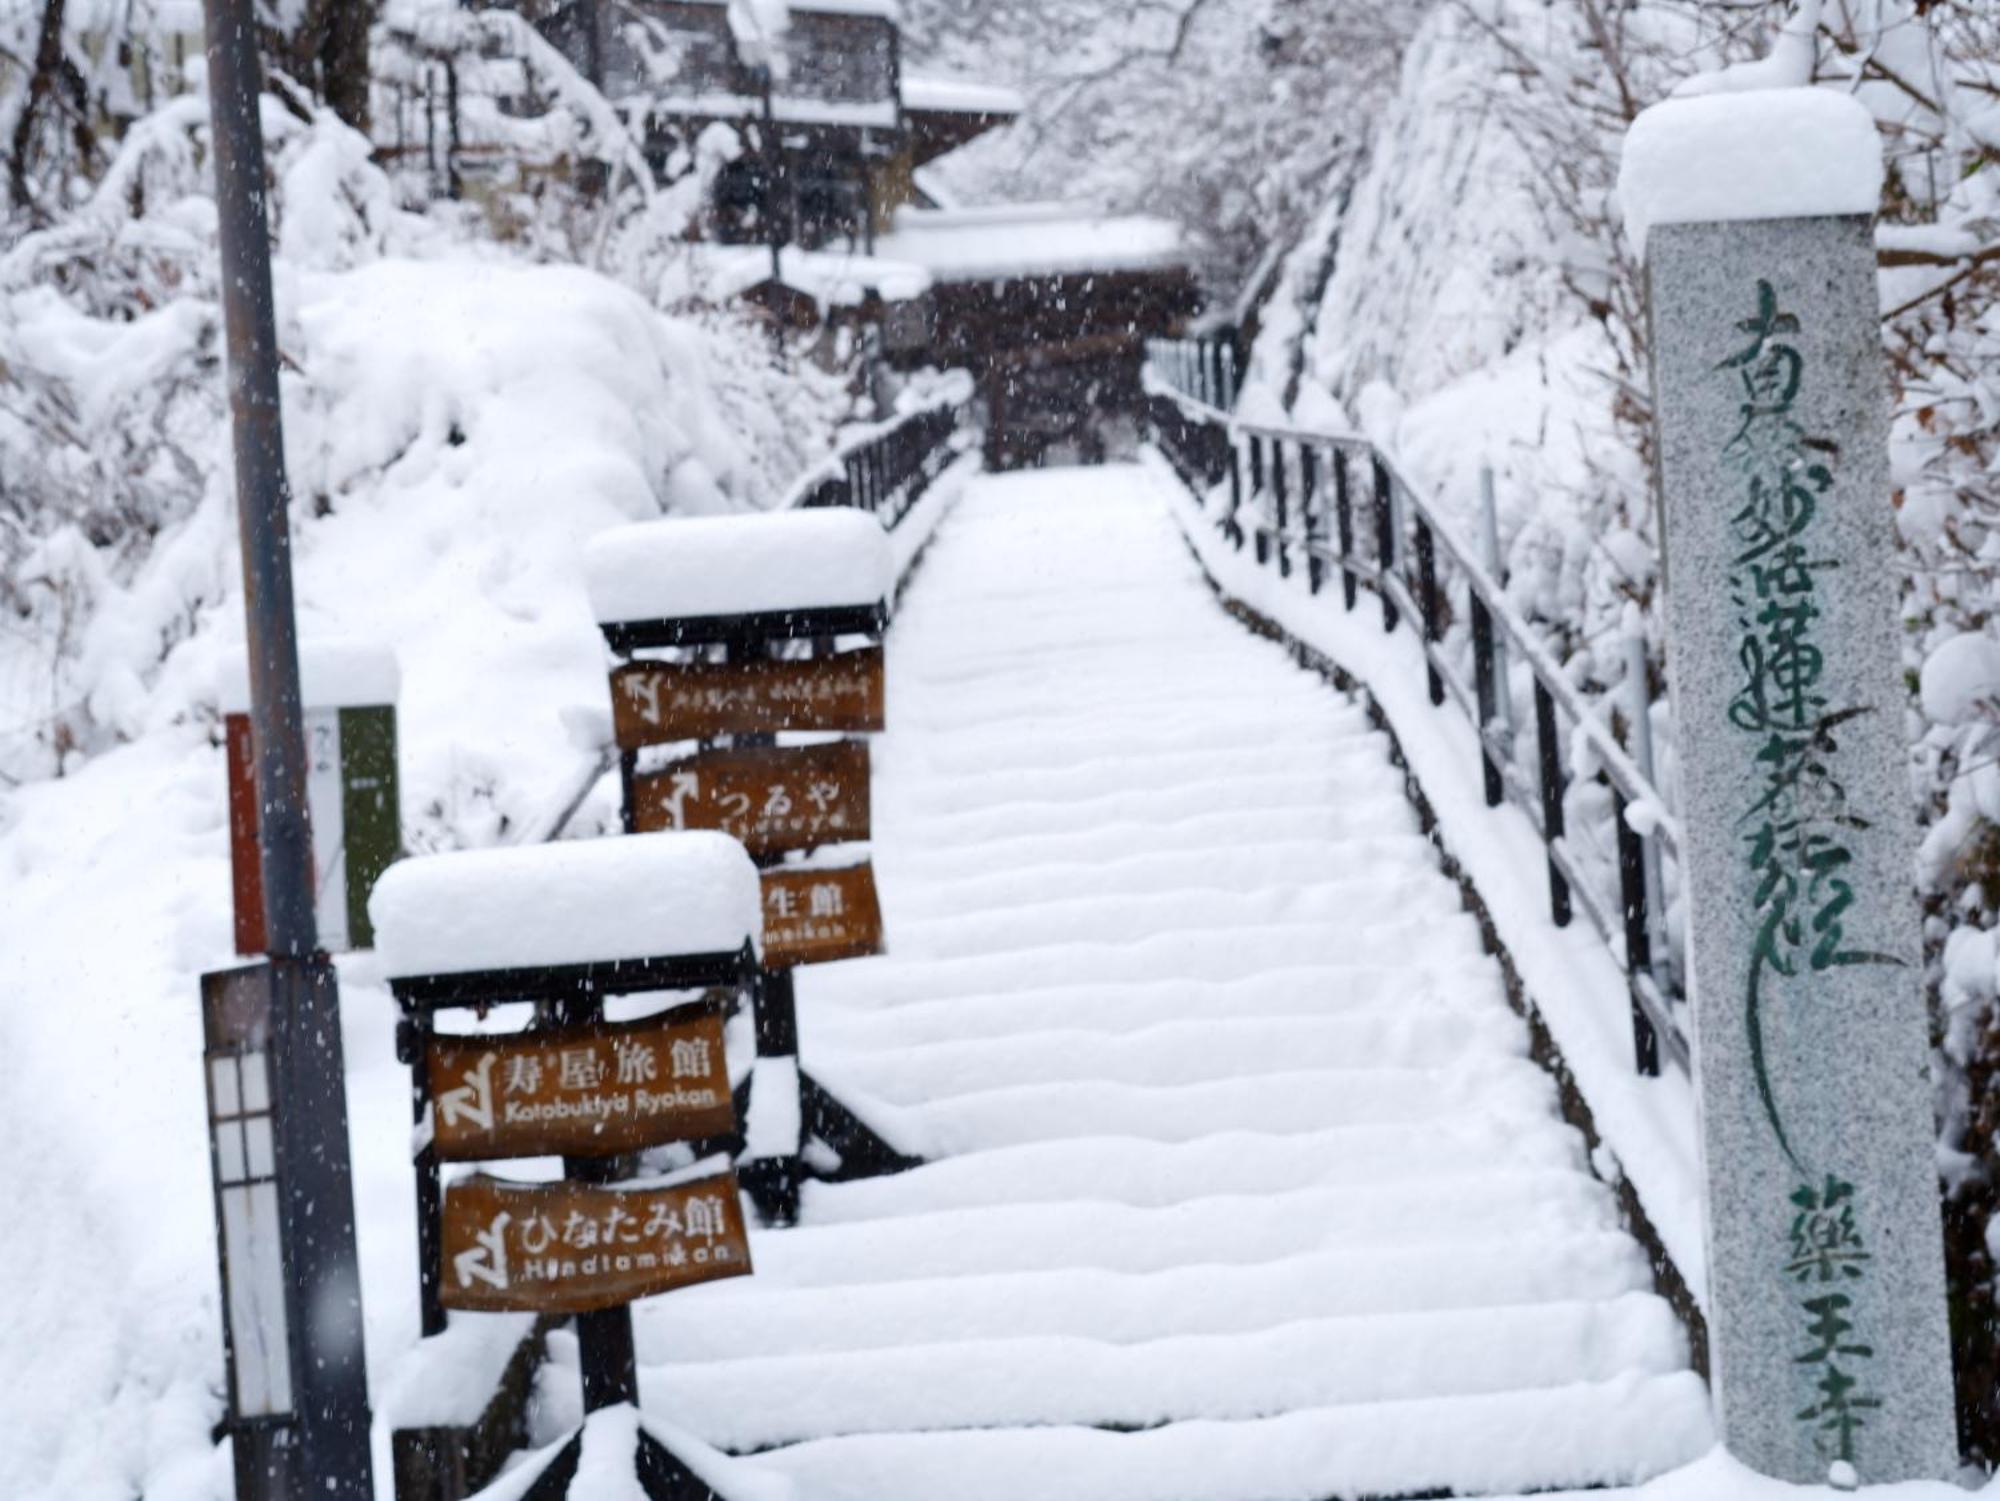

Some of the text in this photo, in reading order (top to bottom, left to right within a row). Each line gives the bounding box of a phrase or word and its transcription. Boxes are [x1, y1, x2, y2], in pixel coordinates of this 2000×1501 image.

[718, 781, 840, 817] つるや
[767, 883, 844, 917] 生館
[505, 1035, 711, 1095] 寿屋旅館
[505, 1086, 716, 1123] Kotobukiya Ryokan
[520, 1195, 726, 1255] ひなたみ館
